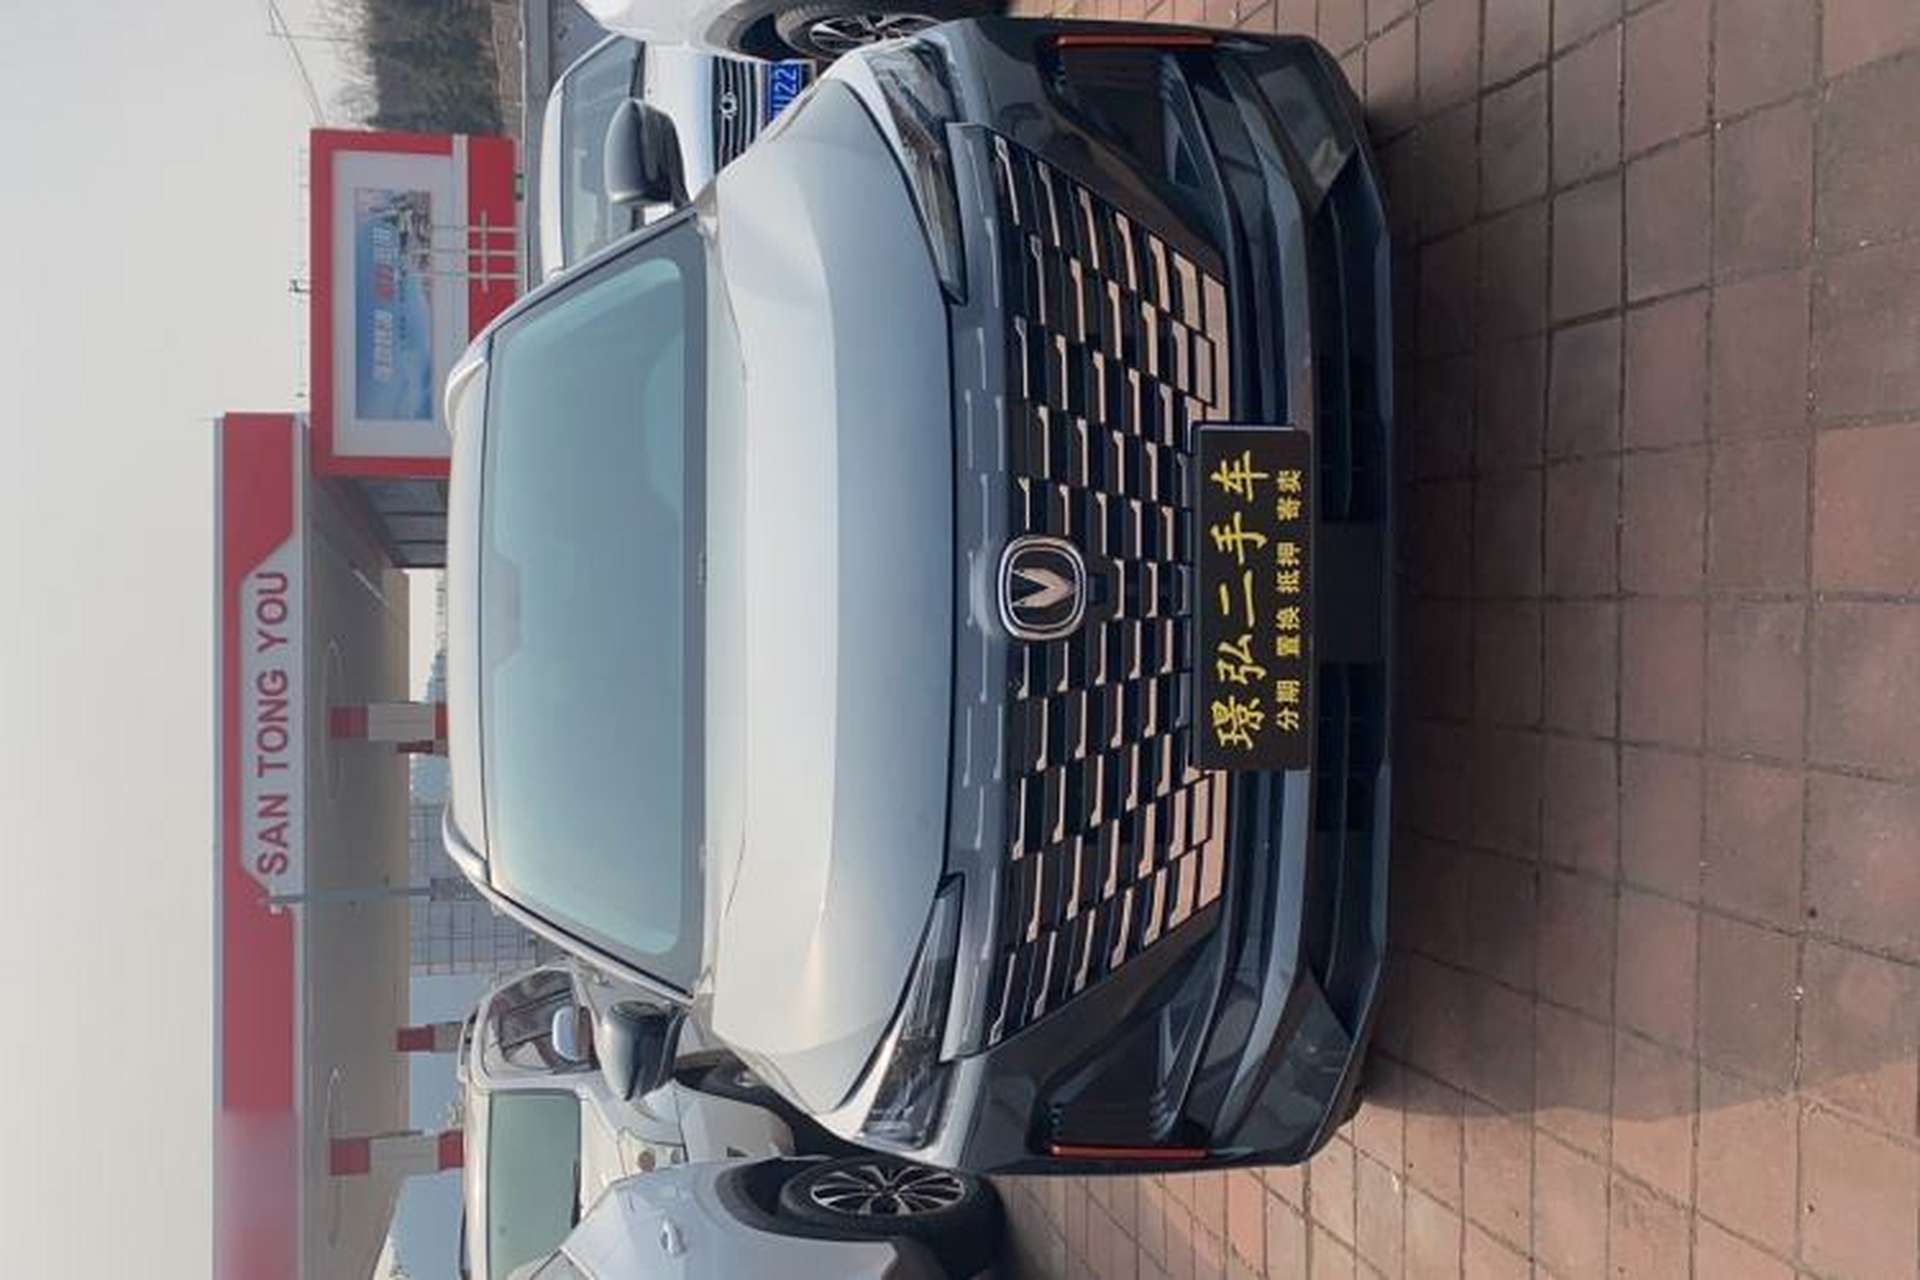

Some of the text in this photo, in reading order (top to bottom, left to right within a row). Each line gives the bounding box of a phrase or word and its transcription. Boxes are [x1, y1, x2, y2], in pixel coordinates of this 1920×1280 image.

[256, 571, 288, 876] SAN TONG YOU
[1209, 449, 1269, 750] 璟弘二手车
[1276, 469, 1302, 731] 分期 置换 抵押 寄卖
